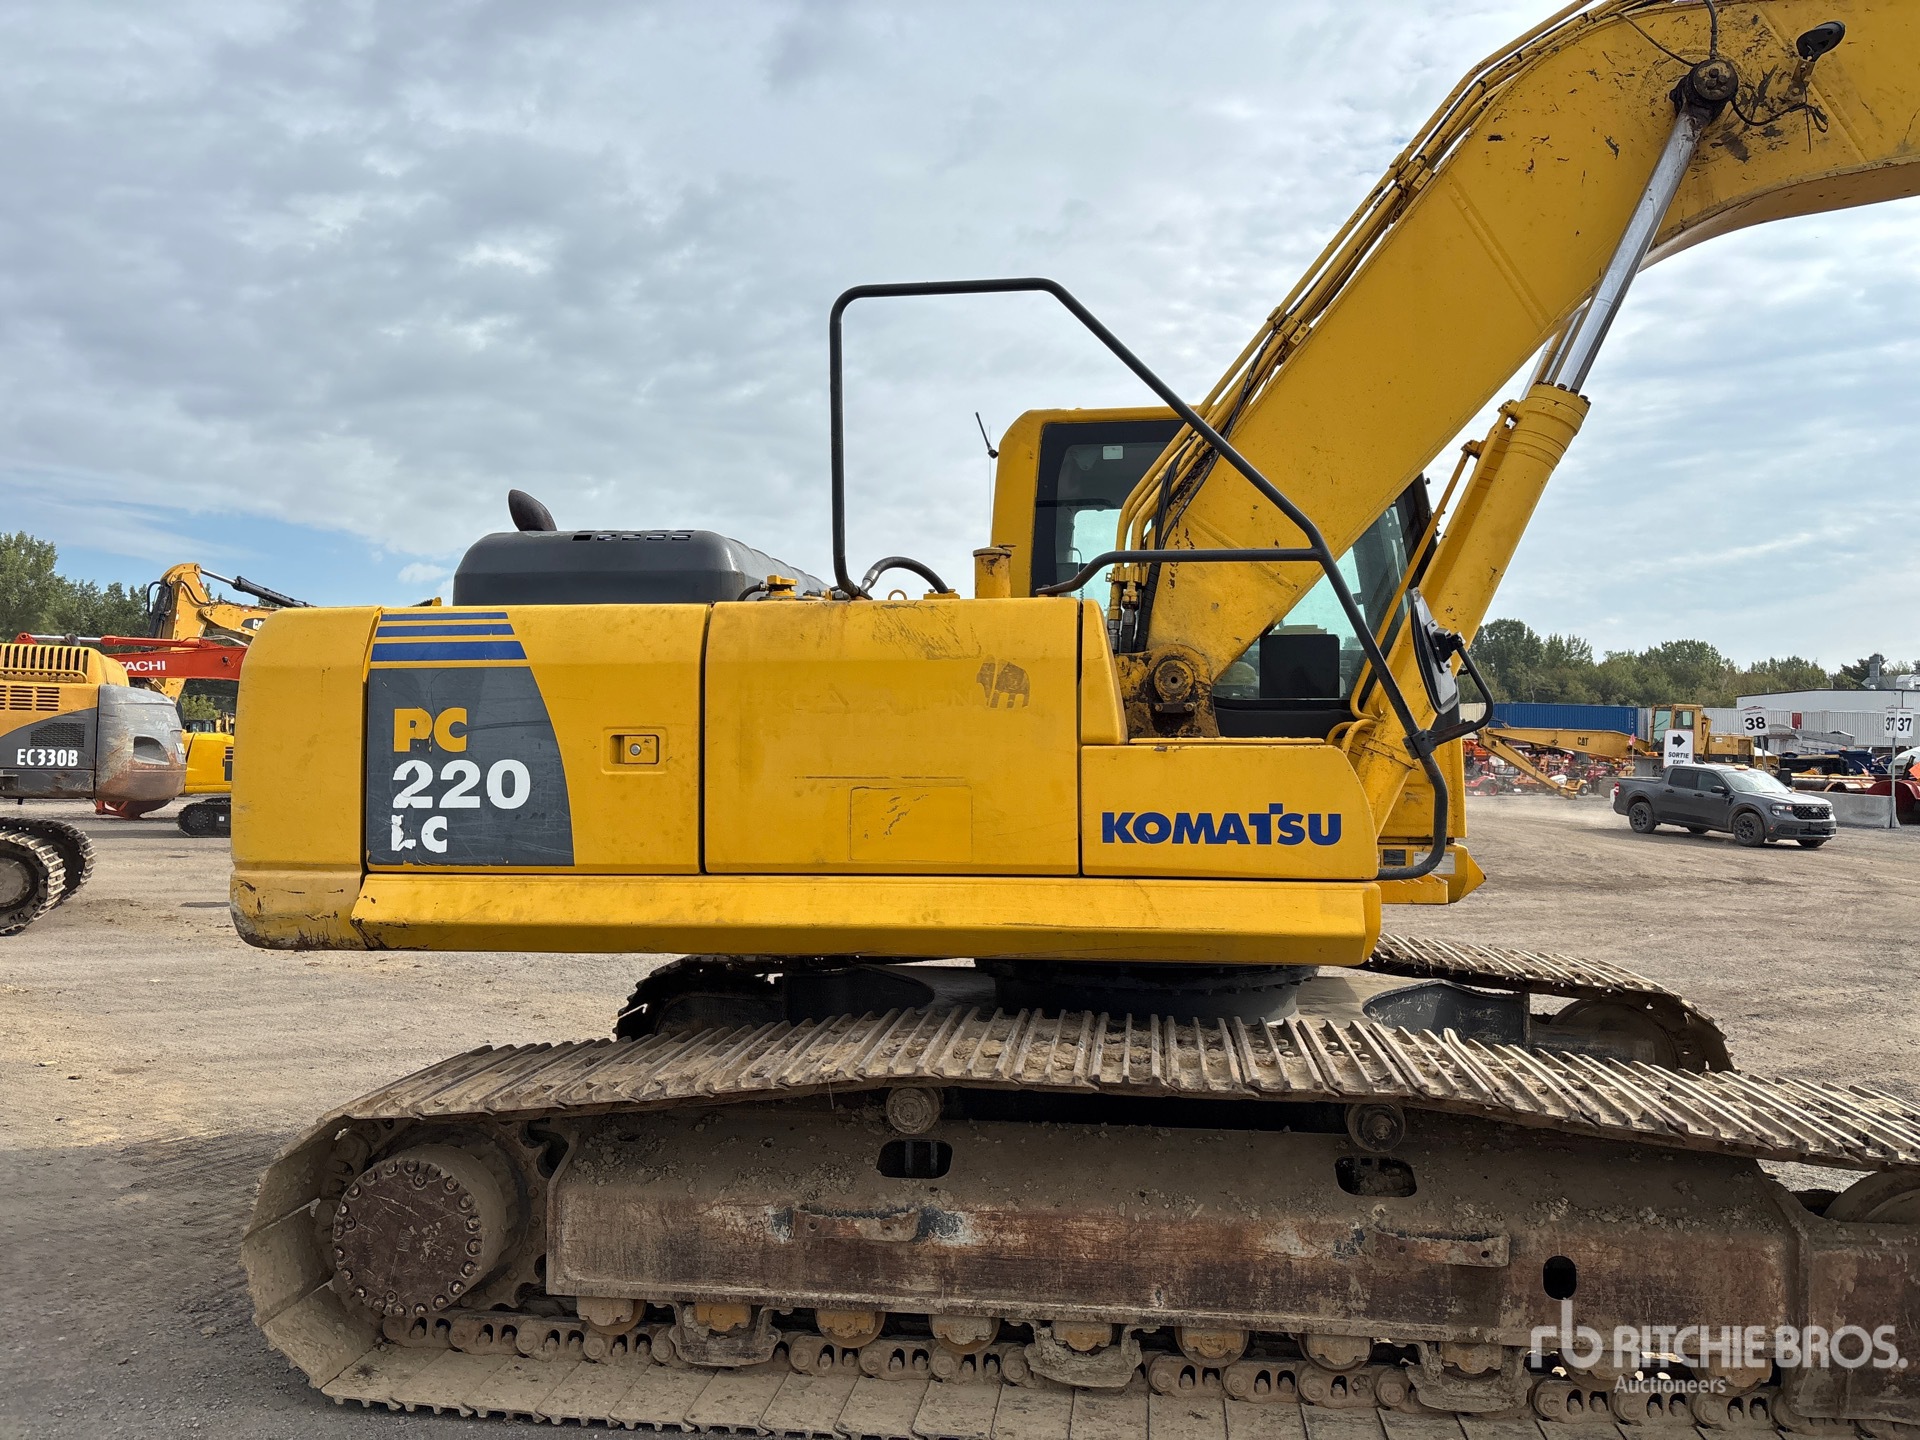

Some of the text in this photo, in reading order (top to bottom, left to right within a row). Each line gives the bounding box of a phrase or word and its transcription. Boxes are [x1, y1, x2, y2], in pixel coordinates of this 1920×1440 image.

[393, 707, 468, 752] PC
[1745, 716, 1766, 731] 38
[1885, 716, 1895, 731] 37
[1897, 717, 1912, 731] 37
[1577, 736, 1589, 746] CAT
[16, 748, 78, 767] EC330B
[1668, 751, 1689, 759] SORTIE
[392, 759, 531, 810] 220
[1102, 803, 1342, 846] KOMATSU
[391, 814, 448, 853] LC
